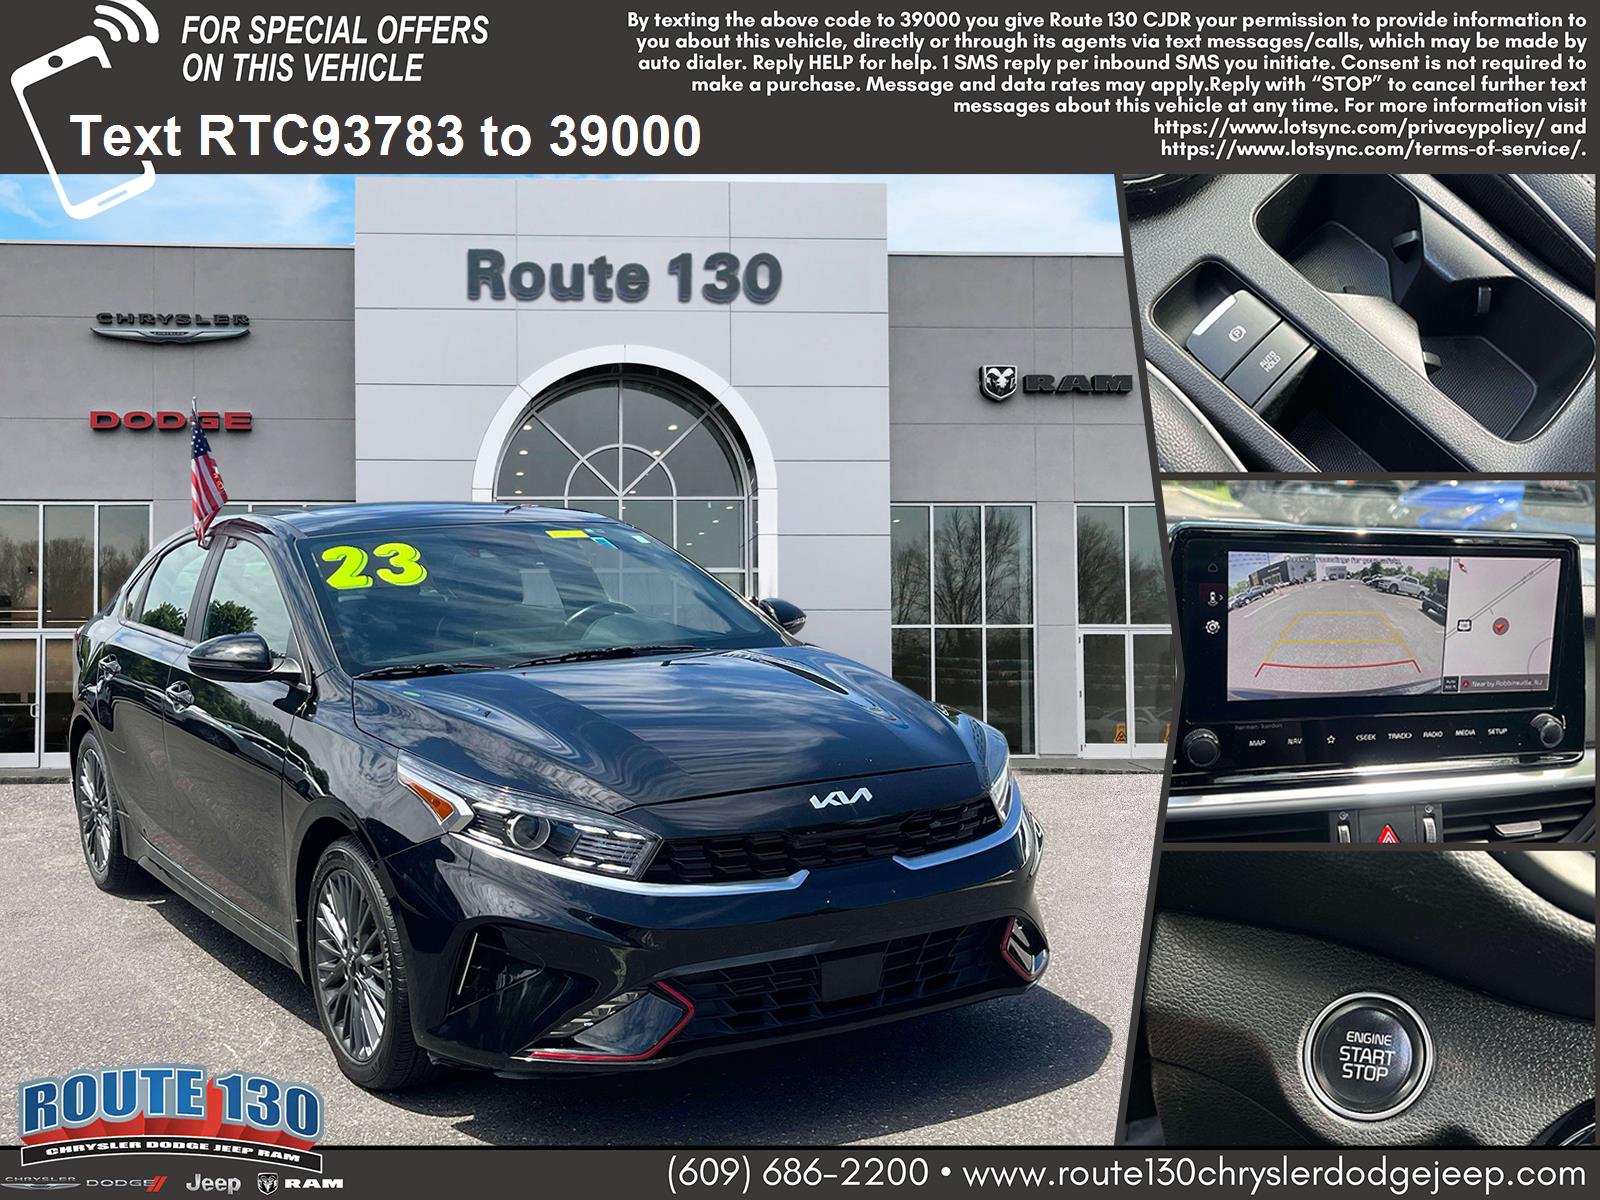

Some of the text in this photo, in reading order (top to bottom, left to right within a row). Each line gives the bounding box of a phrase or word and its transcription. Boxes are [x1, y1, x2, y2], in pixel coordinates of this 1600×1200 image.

[467, 249, 782, 304] Route 130
[96, 313, 250, 325] CHRYSLER
[1260, 351, 1277, 368] AUTO
[1264, 355, 1281, 372] HOLD
[1023, 374, 1133, 395] RAM
[90, 411, 252, 430] DODGE
[322, 542, 428, 590] 23
[1423, 729, 1443, 738] RADIO
[1455, 729, 1476, 737] MEDIA
[1249, 739, 1266, 747] MAP
[1346, 1031, 1392, 1046] ENGINE
[1340, 1046, 1396, 1066] START
[1342, 1063, 1388, 1081] STOP
